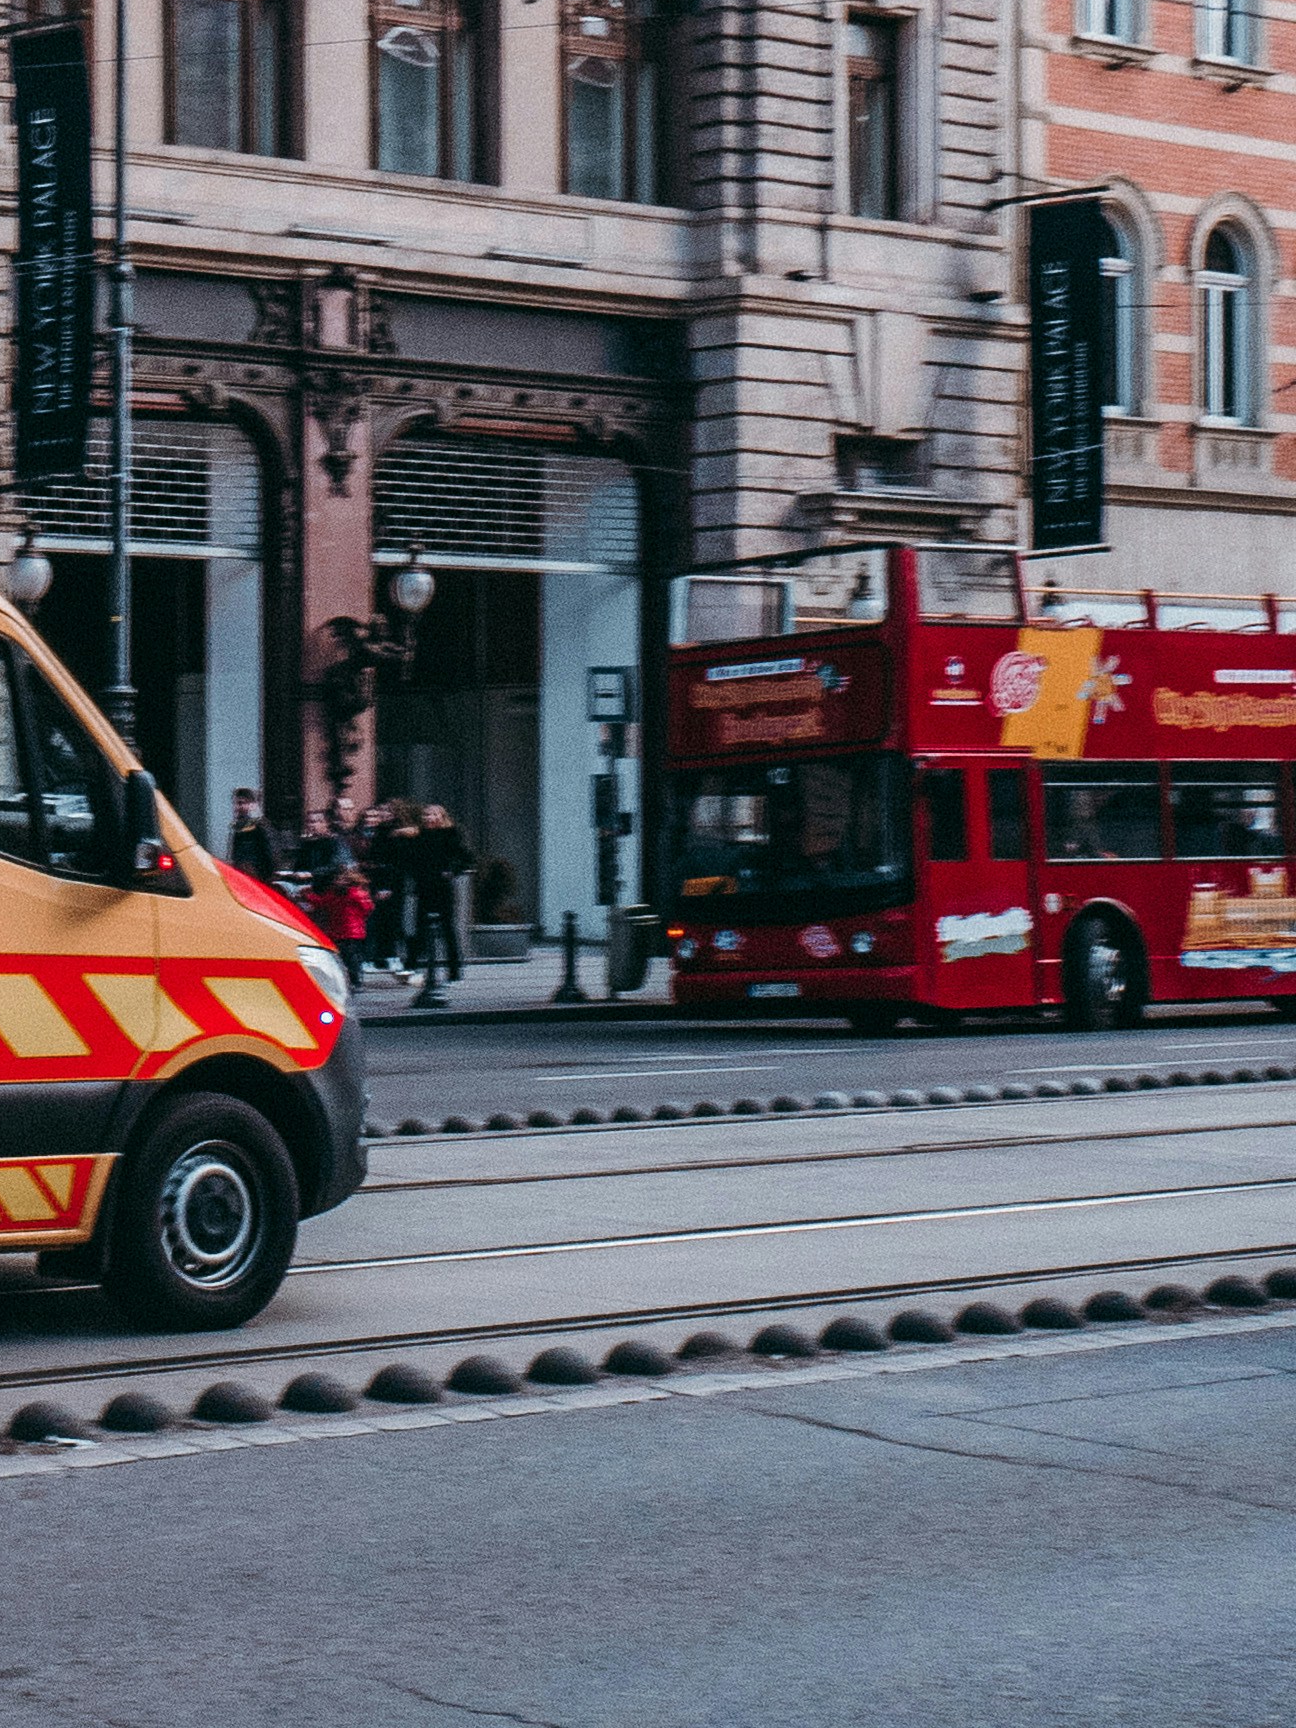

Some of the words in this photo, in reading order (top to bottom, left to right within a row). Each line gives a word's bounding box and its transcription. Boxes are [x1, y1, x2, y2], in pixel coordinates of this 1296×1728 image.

[29, 107, 57, 227] PALACE
[31, 239, 57, 331] YORK
[1040, 259, 1070, 355] PALACE
[31, 342, 57, 414] NEW
[1044, 363, 1071, 437] YORK
[1043, 445, 1070, 502] NEW
